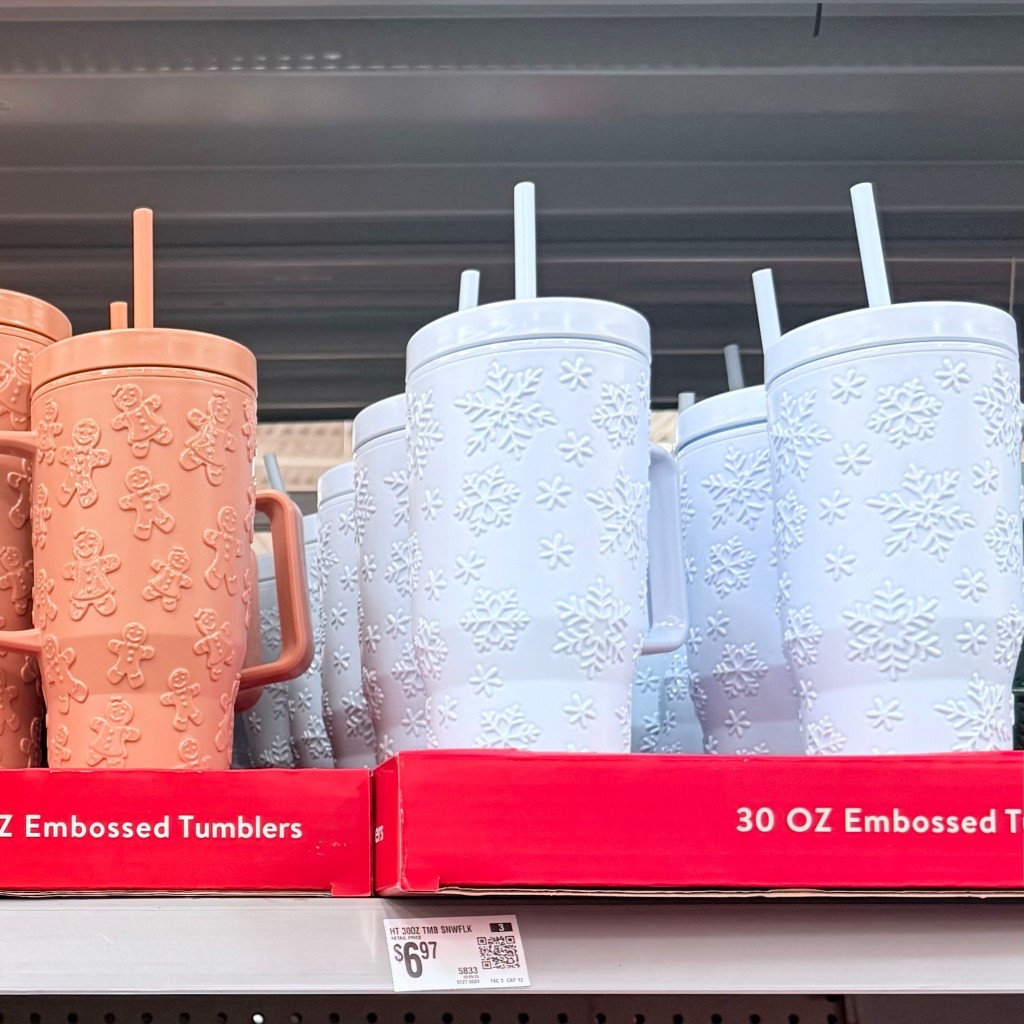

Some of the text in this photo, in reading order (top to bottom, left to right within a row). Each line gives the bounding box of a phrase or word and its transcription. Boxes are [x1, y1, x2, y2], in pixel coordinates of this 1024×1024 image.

[736, 807, 1024, 834] 30 OZ Embossed T
[26, 814, 170, 839] Embossed
[179, 815, 302, 839] Tumblers
[390, 927, 399, 935] HT
[422, 926, 439, 934] TMB
[441, 925, 473, 934] SNWFLK
[498, 924, 504, 932] 3
[458, 966, 479, 975] 5833
